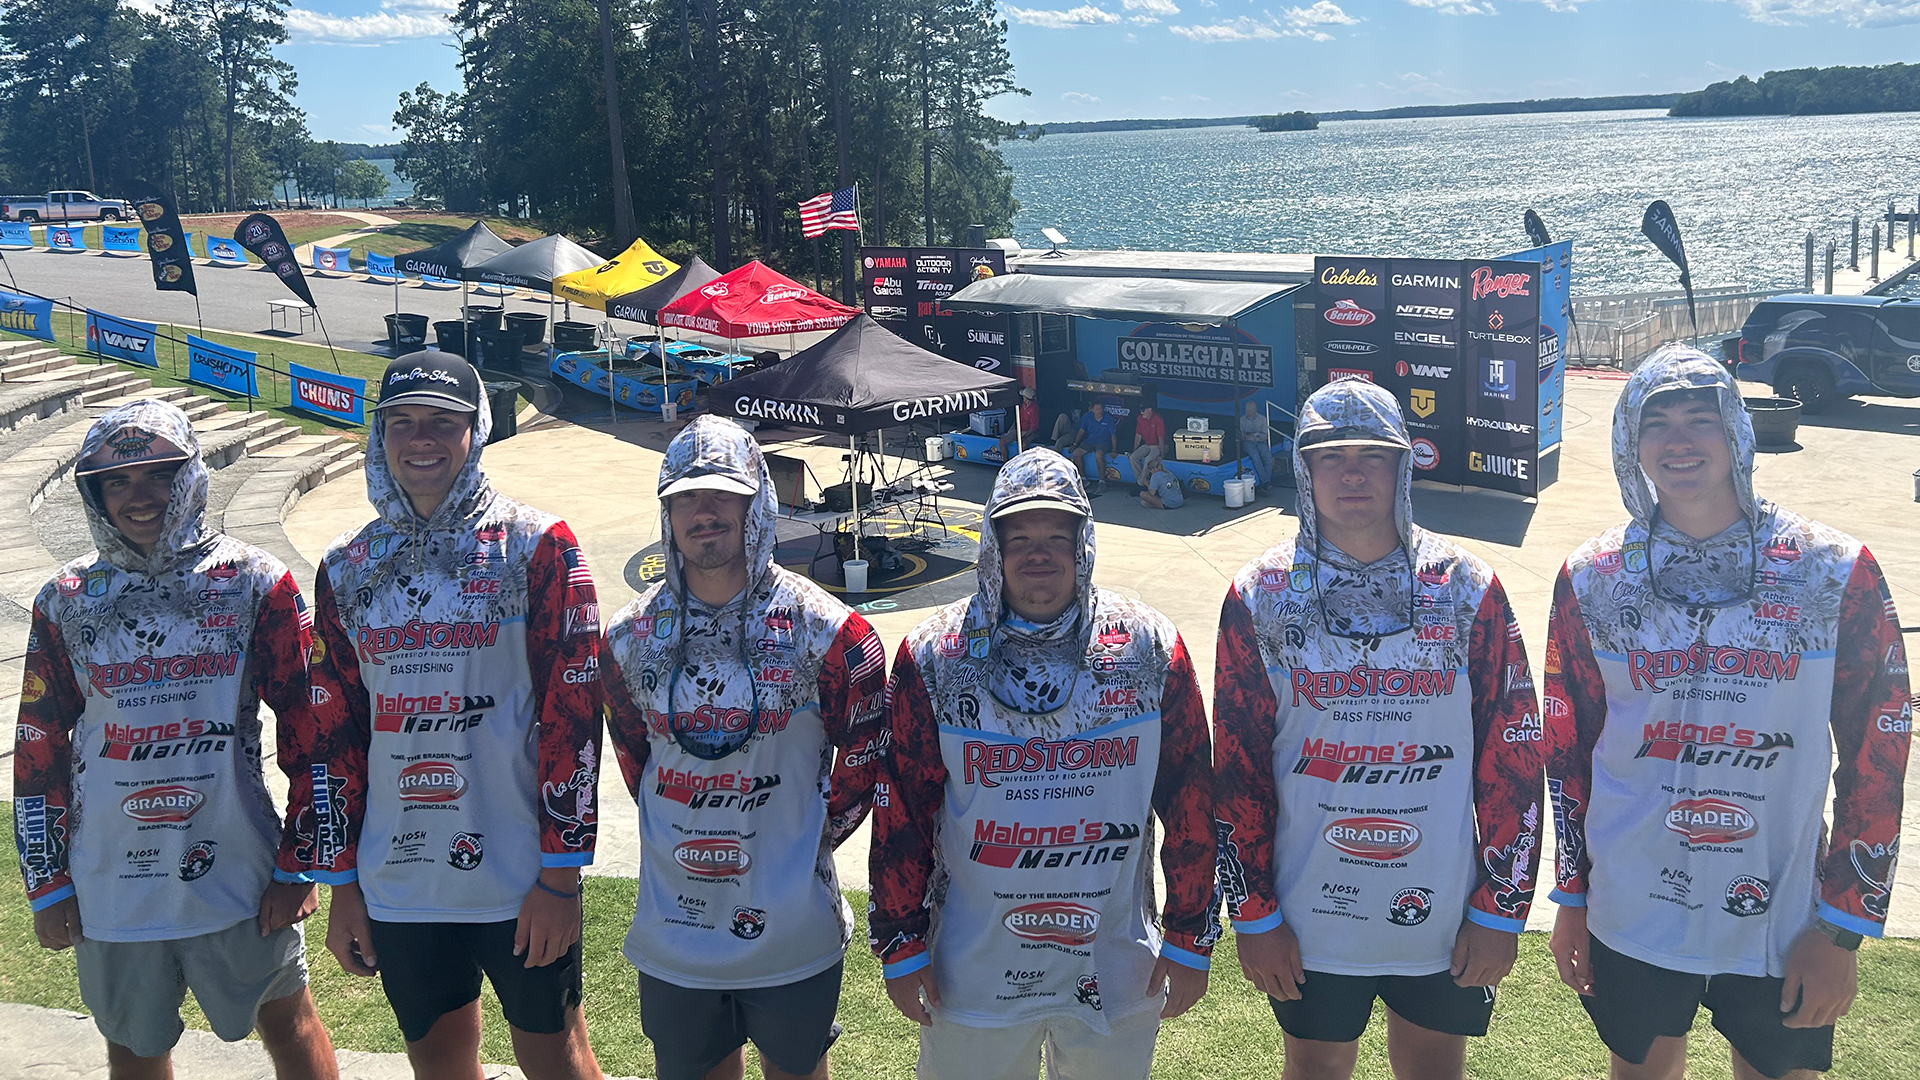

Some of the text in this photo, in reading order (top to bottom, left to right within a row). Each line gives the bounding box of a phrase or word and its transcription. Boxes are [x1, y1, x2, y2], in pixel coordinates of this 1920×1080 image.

[251, 225, 263, 237] 20
[268, 246, 278, 255] 20
[405, 260, 448, 277] GARMIN
[874, 257, 908, 268] YAMAHA
[916, 260, 952, 268] OUTDOOR
[884, 278, 902, 288] Abu
[1321, 266, 1378, 287] Cabela's
[1391, 274, 1460, 289] GARMIN
[1470, 265, 1531, 301] Ranger
[873, 286, 903, 296] Garcia
[916, 280, 954, 291] Triton
[767, 289, 803, 304] Berkley
[614, 304, 648, 322] GARMIN
[871, 306, 907, 316] SPRO
[1329, 310, 1370, 323] Berkley
[0, 308, 38, 331] ufix
[746, 322, 770, 335] YOUR
[797, 319, 813, 330] OUR
[102, 330, 149, 353] VMC
[968, 328, 1005, 346] SUNLINE
[1394, 331, 1455, 345] ENGEL
[1467, 330, 1532, 345] TURTLEBOX
[1328, 343, 1372, 351] POWER-POLE
[1121, 340, 1270, 370] COLLEGIATE
[389, 372, 410, 385] Bass
[409, 367, 429, 380] Pro
[1121, 361, 1157, 374] BASS
[1160, 363, 1217, 380] FISHING
[1410, 363, 1452, 379] VMC
[299, 379, 351, 409] CHUMS
[1484, 391, 1509, 400] MARINE
[734, 396, 820, 425] GARMIN
[893, 388, 989, 422] GARMIN
[1466, 416, 1531, 434] HYDROWAVE
[349, 544, 365, 558] MLF
[1623, 542, 1644, 553] BASS
[1596, 554, 1618, 567] MLF
[87, 571, 107, 580] BASS
[471, 569, 497, 577] Athens
[1288, 564, 1310, 573] BASS
[462, 579, 501, 594] ACE
[1262, 573, 1284, 585] MLF
[1763, 591, 1795, 601] Athens
[62, 603, 115, 622] Cameron
[208, 605, 234, 613] Athens
[1272, 598, 1315, 619] Noah
[1754, 601, 1801, 621] ACE
[201, 614, 239, 629] ACE
[1423, 614, 1450, 622] Athens
[1754, 619, 1799, 629] Hardware
[201, 627, 238, 635] Hardware
[969, 629, 989, 638] BASS
[1416, 623, 1455, 640] ACE
[942, 637, 964, 650] MLF
[763, 657, 790, 666] Athens
[756, 666, 794, 683] ACE
[951, 666, 986, 687] Alex
[1105, 678, 1132, 686] Athens
[112, 685, 151, 694] UNIVERSITY
[1732, 679, 1768, 688] GRANDE
[117, 690, 198, 709] BASS FISHING
[1098, 687, 1137, 705] ACE
[1327, 699, 1367, 707] UNIVERSITY
[1099, 705, 1137, 713] Hardware
[1333, 711, 1412, 722] BASS FISHING
[104, 717, 205, 743] Malone's
[131, 738, 227, 761] Marine
[1301, 737, 1418, 762] Malone's
[1680, 745, 1779, 770] Marine
[658, 766, 752, 793] Malone's
[1000, 774, 1045, 782] UNIVERSITY
[1081, 770, 1112, 779] GRANDE
[1342, 764, 1442, 784] Marine
[1005, 785, 1095, 801] BASS FISHING
[1732, 791, 1766, 801] PROMISE
[127, 794, 199, 811] BRADEN
[689, 792, 771, 812] Marine
[1318, 802, 1336, 812] HOME
[1399, 804, 1428, 815] PROMISE
[974, 819, 1103, 845] Malone's
[1332, 825, 1415, 843] BRADEN
[1018, 845, 1129, 869] Marine
[1339, 857, 1408, 869] BRADENCDJR.COM
[1046, 891, 1080, 899] BRADEN
[1011, 912, 1098, 929] BRADEN
